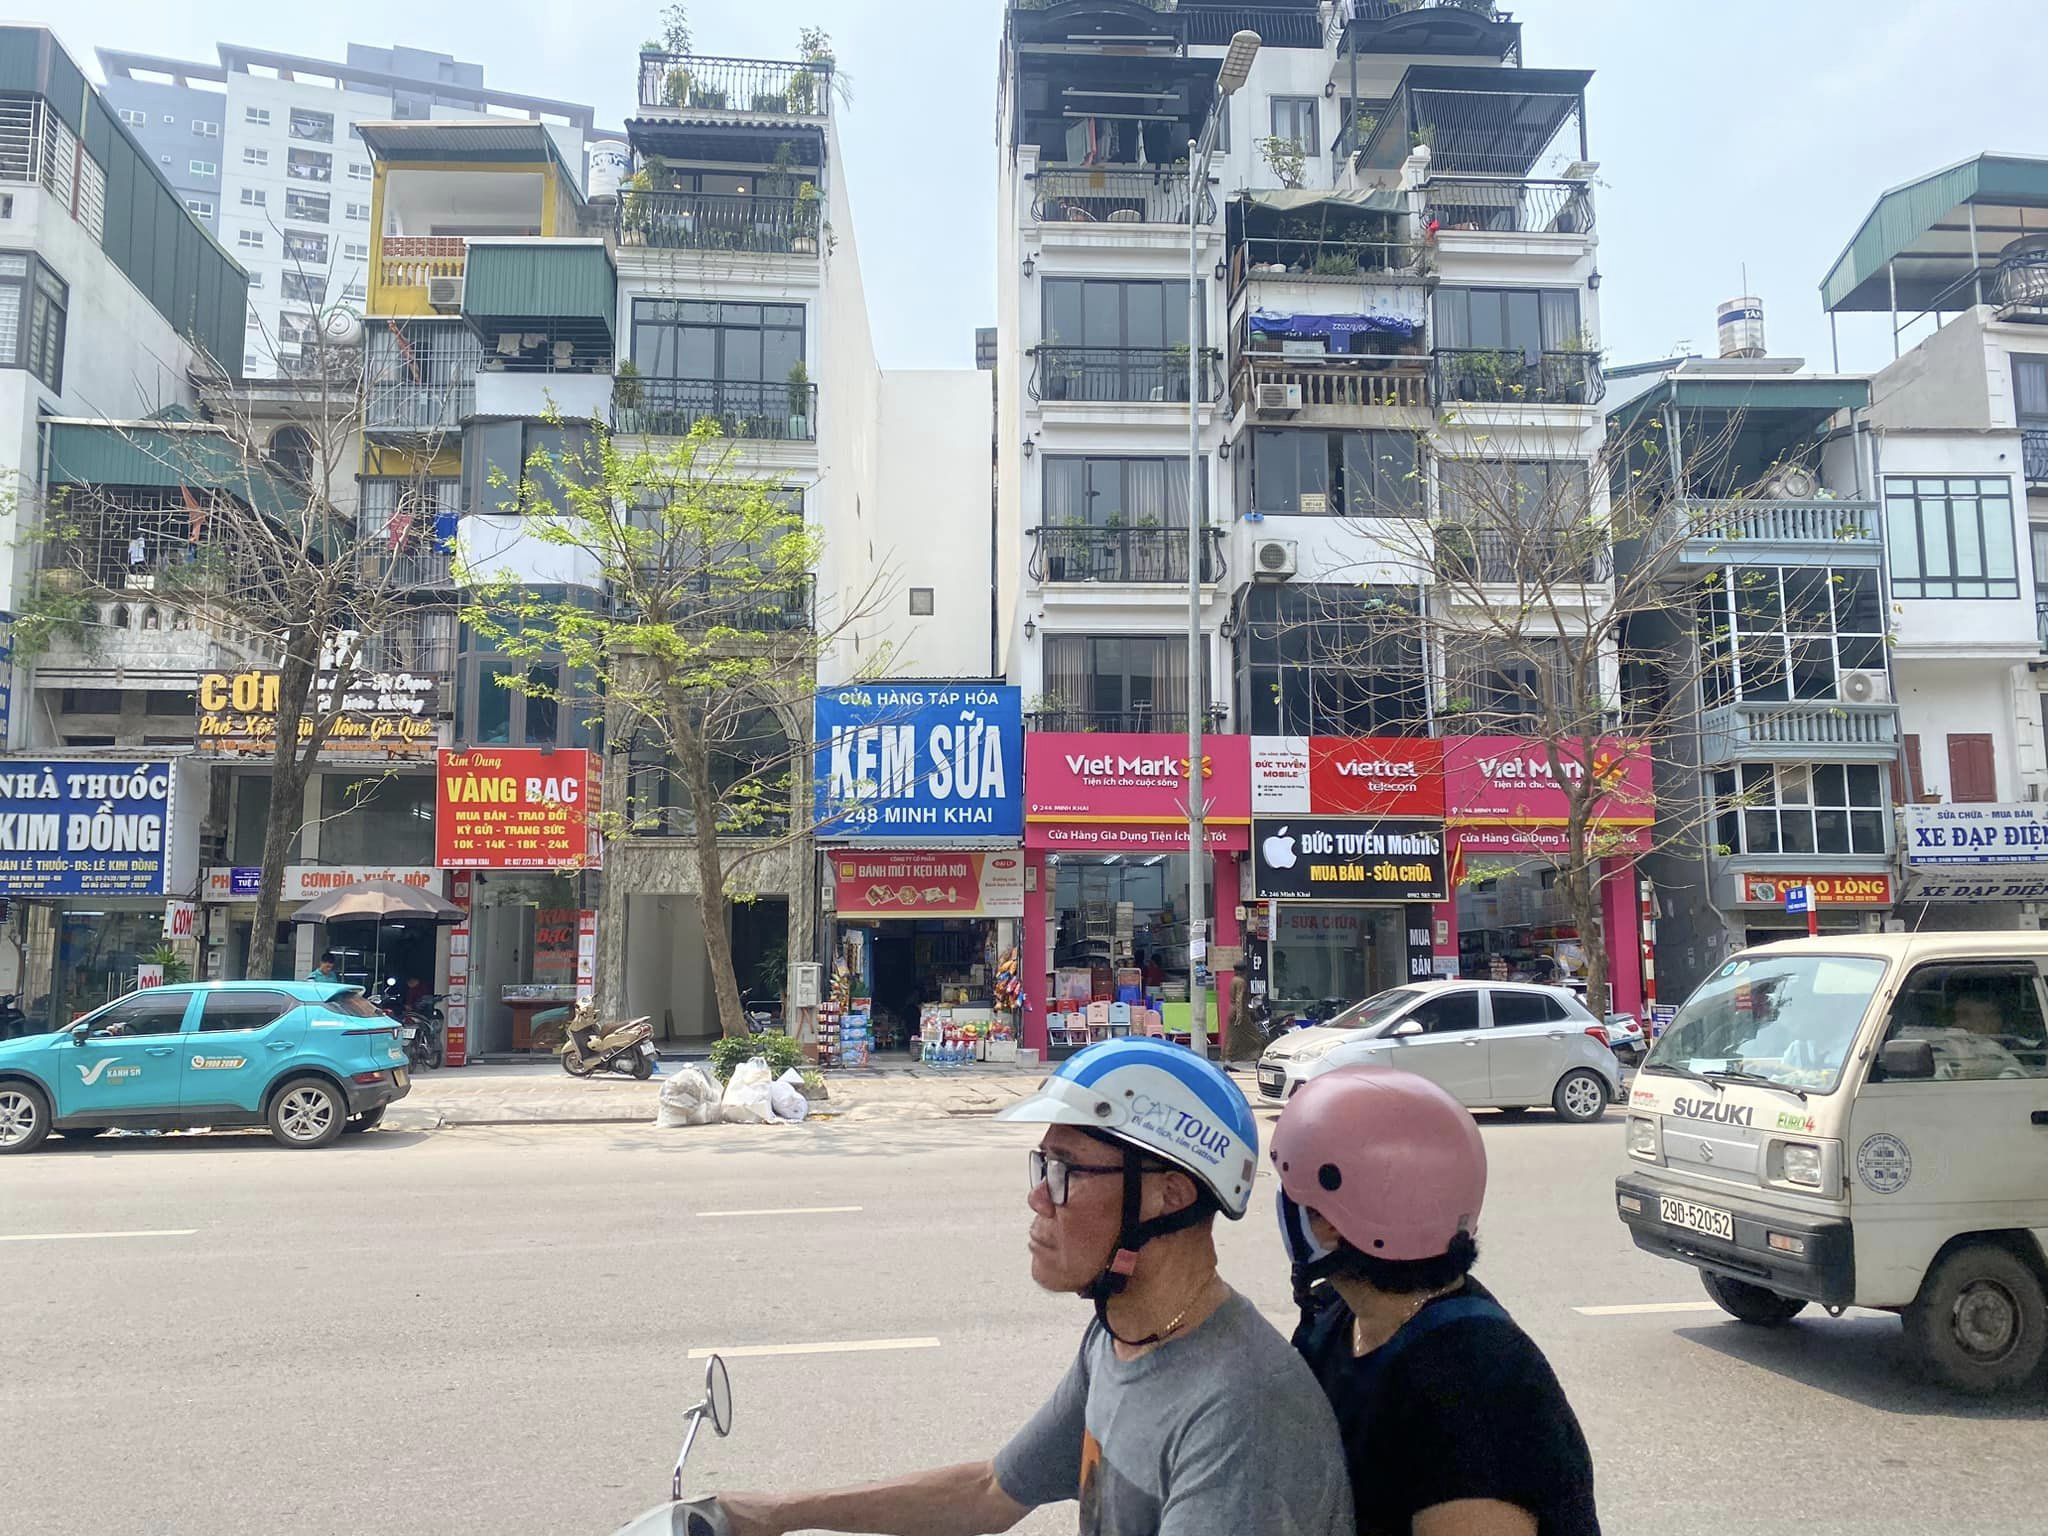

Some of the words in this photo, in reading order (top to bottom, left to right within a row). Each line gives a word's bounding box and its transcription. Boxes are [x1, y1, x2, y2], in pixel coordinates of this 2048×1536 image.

[839, 688, 872, 705] CỬA
[878, 690, 923, 705] HÀNG
[928, 692, 959, 708] TẠP
[965, 690, 999, 705] HÓA
[398, 715, 432, 743] Quê
[444, 753, 469, 767] Kim
[471, 752, 503, 770] Dung
[830, 725, 915, 799] KEM
[928, 710, 1006, 800] SỮA
[1065, 754, 1113, 775] Viet
[1118, 754, 1179, 777] Mark
[1263, 770, 1299, 778] MOBILE
[1335, 758, 1418, 778] viettel
[1477, 757, 1526, 778] Viet
[0, 766, 60, 799] NHÀ
[67, 763, 168, 800] THUỐC
[446, 772, 517, 803] VÀNG
[1083, 777, 1102, 787] Tiện
[1103, 777, 1117, 786] ích
[1118, 777, 1134, 786] cho
[1135, 778, 1156, 789] cuộc
[1157, 776, 1179, 789] sống
[1367, 780, 1417, 792] telecom
[456, 811, 481, 821] MUA
[483, 810, 507, 821] BÁN
[517, 811, 545, 821] TRAO
[844, 807, 878, 823] 248
[885, 807, 936, 824] MINH
[944, 807, 993, 824] KHAI
[1937, 809, 1956, 820] SỬA
[1958, 809, 1984, 819] CHỮA
[2014, 809, 2034, 818] BÁN
[0, 813, 60, 851] KIM
[66, 800, 161, 852] ĐỒNG
[504, 825, 540, 835] TRANG
[543, 824, 566, 835] SỨC
[453, 839, 474, 849] 10K
[485, 839, 506, 849] 14K
[517, 839, 537, 849] 18K
[548, 839, 569, 849] 24K
[1048, 829, 1068, 841] Cửa
[1070, 829, 1097, 842] Hàng
[1100, 830, 1117, 841] Gia
[1119, 830, 1148, 843] Dụng
[1150, 829, 1172, 842] Tiện
[1210, 828, 1227, 842] Tốt
[1301, 830, 1333, 855] ĐỨC
[1459, 831, 1480, 843] Cửa
[1482, 832, 1509, 846] Hàng
[1531, 832, 1559, 847] Dụng
[1915, 827, 1947, 847] XE
[1951, 826, 1998, 852] ĐẠP
[109, 860, 129, 871] KIM
[858, 863, 885, 878] BÁNH
[887, 862, 912, 878] MỨT
[913, 864, 933, 879] KẸO
[949, 863, 967, 879] NỘI
[1310, 864, 1338, 882] MUA
[1339, 862, 1364, 882] BÁN
[1374, 860, 1399, 882] SỬA
[1400, 862, 1433, 882] CHỮA
[238, 878, 252, 888] TUỆ
[253, 879, 261, 887] A
[301, 871, 333, 889] CƠM
[403, 871, 432, 889] HỘP
[1834, 876, 1885, 894] LÒNG
[1917, 886, 1951, 897] XE
[1951, 885, 2001, 899] ĐẠP
[173, 905, 193, 936] CƠM
[1409, 928, 1430, 946] MUA
[1253, 955, 1262, 970] ÉP
[1411, 954, 1431, 976] BÁN
[1250, 979, 1266, 994] KÍNH
[106, 1069, 129, 1078] XANH
[1672, 1096, 1754, 1126] SUZUKI
